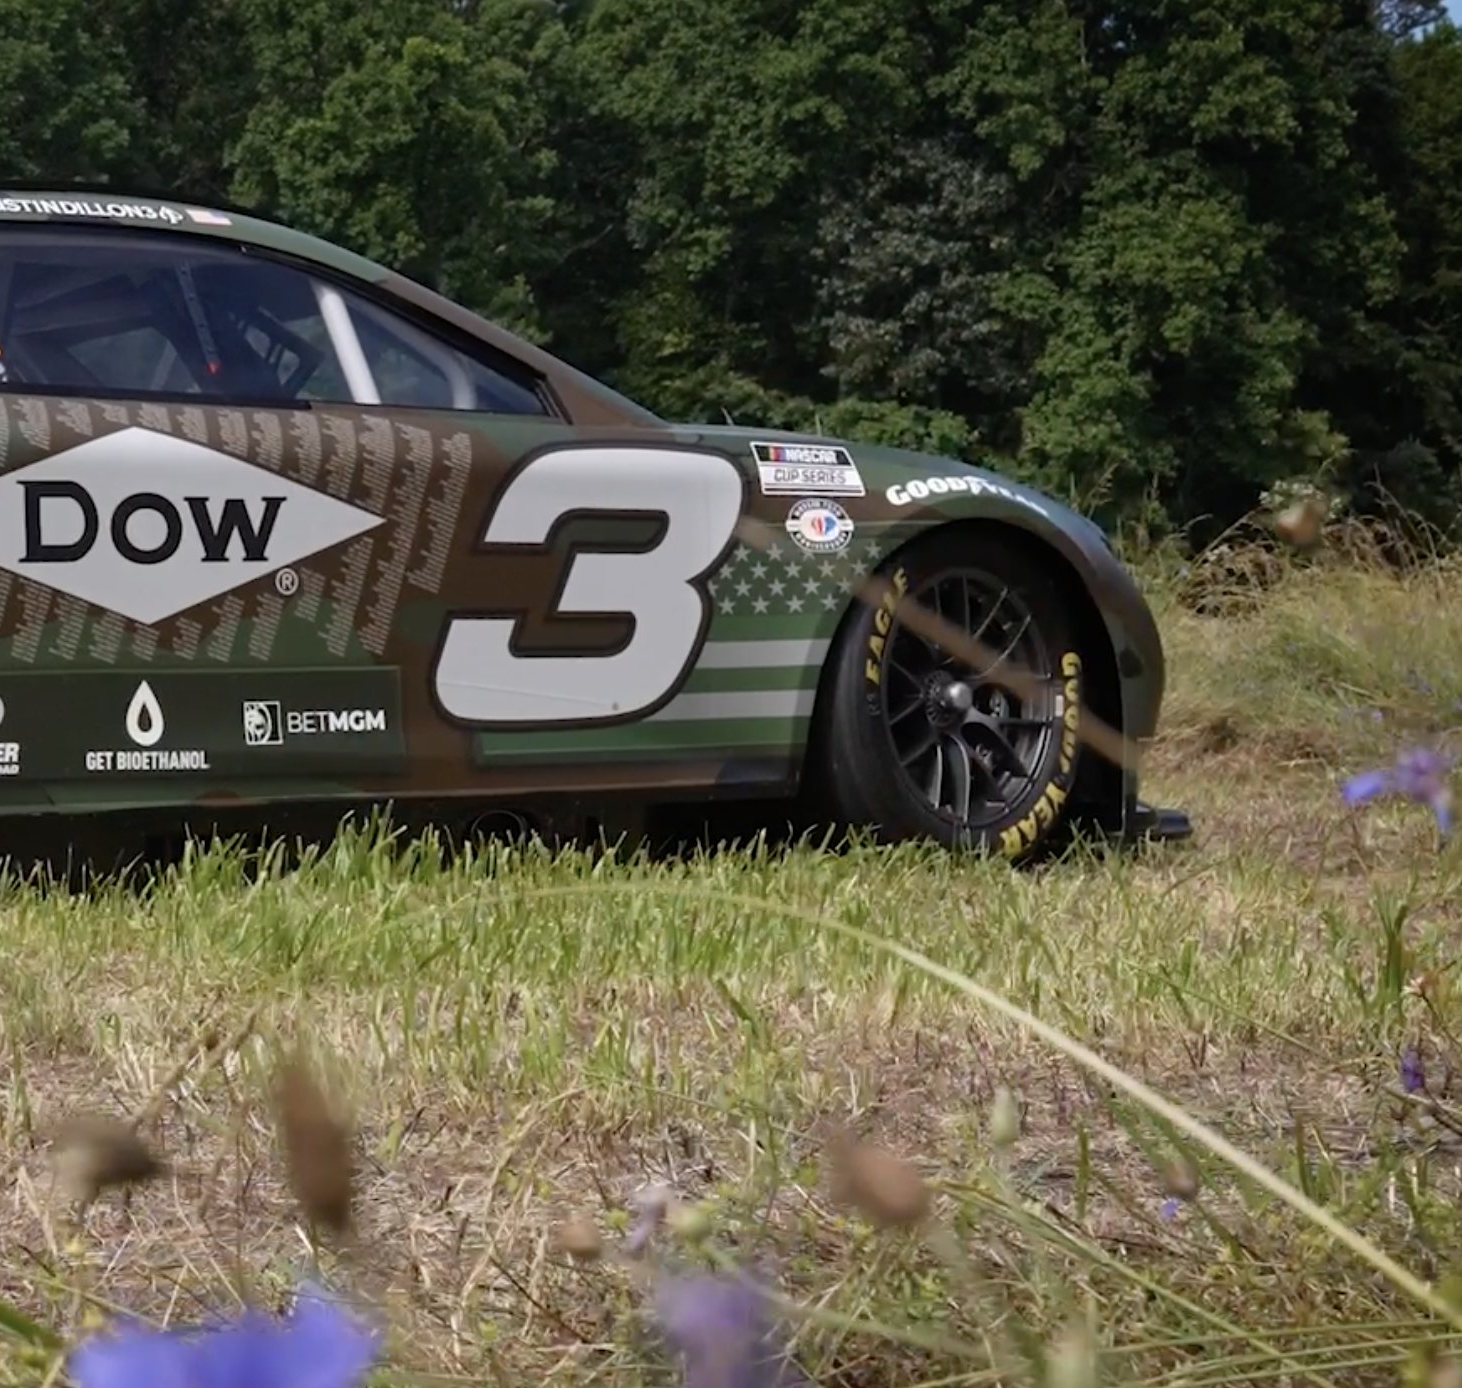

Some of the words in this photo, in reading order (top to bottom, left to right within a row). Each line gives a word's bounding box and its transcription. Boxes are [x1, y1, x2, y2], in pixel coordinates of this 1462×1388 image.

[785, 448, 838, 464] NASCAR
[774, 469, 799, 482] CUP
[801, 470, 847, 484] SERIES
[435, 446, 743, 722] 3
[286, 709, 386, 733] BETMGM
[85, 750, 114, 771] GET
[116, 749, 211, 771] BIOETHANOL
